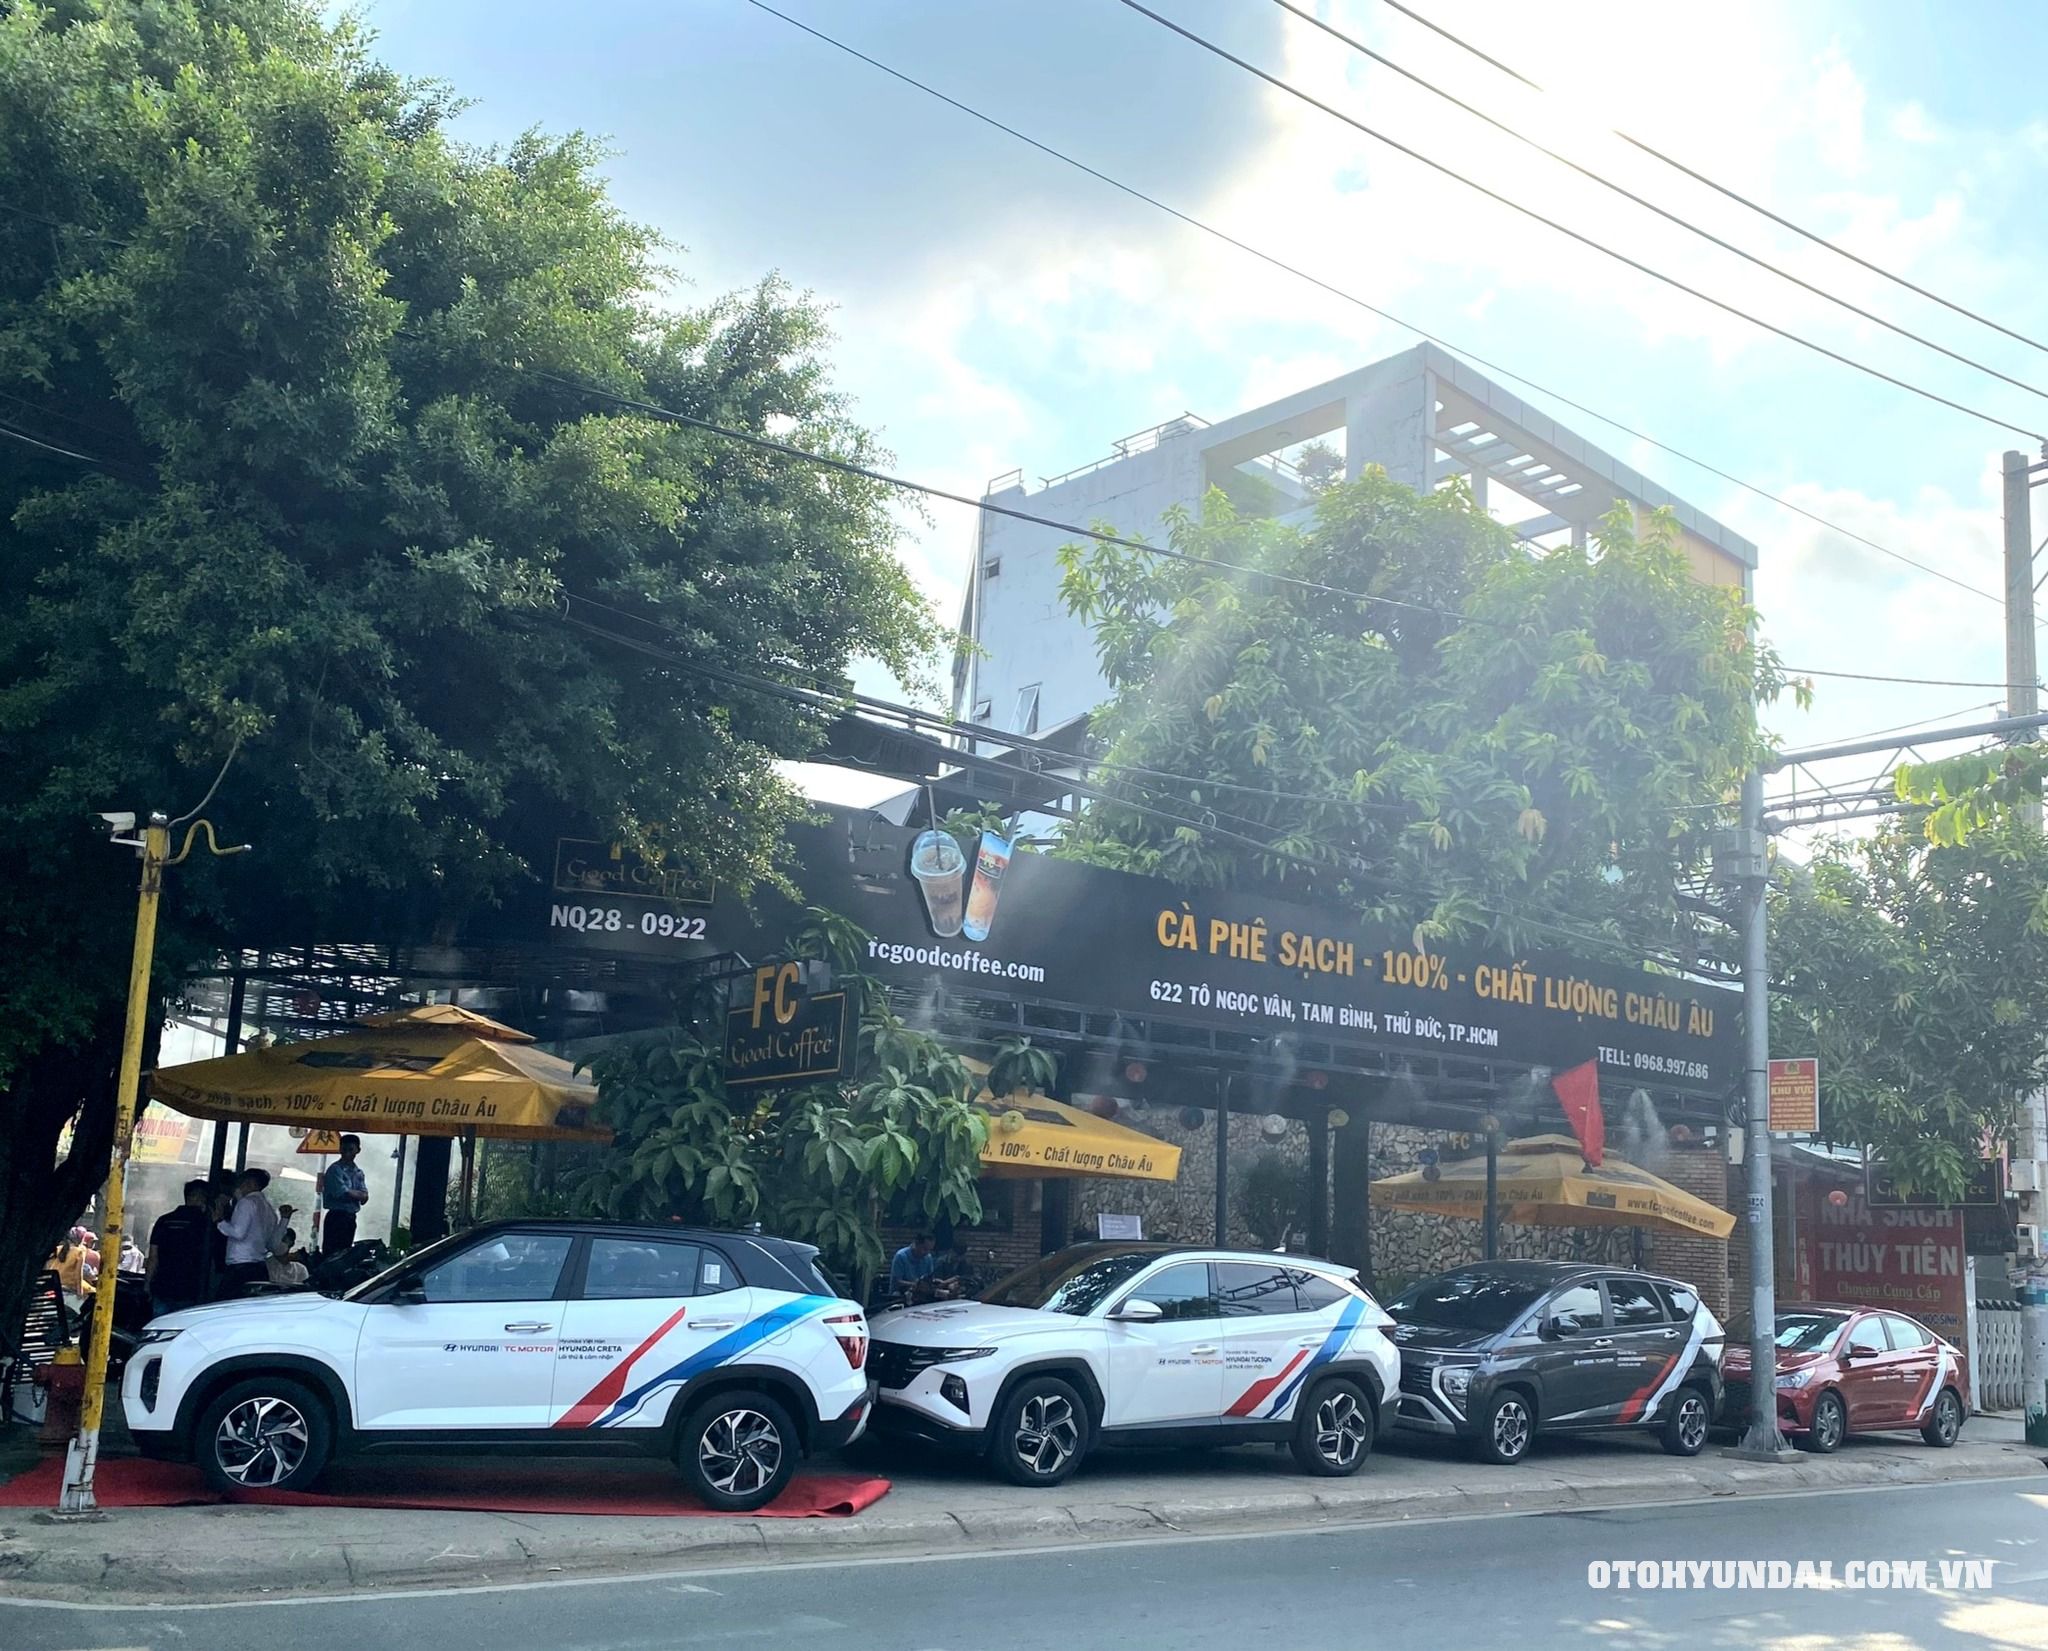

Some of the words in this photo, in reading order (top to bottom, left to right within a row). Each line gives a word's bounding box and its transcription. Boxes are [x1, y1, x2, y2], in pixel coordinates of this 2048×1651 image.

[567, 859, 625, 882] Good
[631, 866, 704, 897] Coffee
[550, 904, 622, 932] NQ28
[641, 912, 707, 940] 0922
[867, 938, 1045, 982] fcgoodcoffee.com
[1157, 901, 1198, 951] CÀ
[1209, 917, 1267, 963] PHÊ
[1278, 931, 1354, 979] SẠCH
[1364, 958, 1372, 967] -
[1383, 949, 1448, 991] 100%
[1457, 974, 1466, 982] -
[1475, 960, 1537, 1005] CHẤT
[1544, 975, 1618, 1022] LƯỢNG
[1625, 992, 1680, 1032] CHÂU
[1688, 999, 1714, 1037] ÂU
[752, 961, 800, 1029] FC
[1150, 980, 1182, 1003] 622
[1189, 983, 1211, 1006] TÔ
[1216, 989, 1258, 1017] NGỌC
[1263, 993, 1296, 1022] VÂN,
[1302, 1001, 1334, 1024] TAM
[1340, 1004, 1378, 1033] BÌNH,
[1384, 1011, 1411, 1035] THỦ
[1415, 1015, 1446, 1042] ĐỨC,
[1448, 1022, 1498, 1047] TP.HCM
[731, 1033, 772, 1065] Good
[776, 1027, 832, 1069] Coffee
[1598, 1046, 1631, 1068] TELL:
[1633, 1054, 1709, 1080] 0968.997.686
[285, 1094, 324, 1110] 100%
[342, 1093, 378, 1113] Chất
[383, 1096, 426, 1118] lượng
[431, 1096, 469, 1117] Châu
[475, 1096, 497, 1117] Âu
[1000, 1142, 1031, 1159] 100%
[1044, 1146, 1069, 1163] Chất
[1073, 1150, 1104, 1169] lượng
[1107, 1153, 1136, 1171] Châu
[1138, 1154, 1153, 1172] Âu
[1452, 1134, 1470, 1150] FC
[1820, 1231, 1887, 1274] THỦY
[1896, 1237, 1959, 1277] TIÊN
[1916, 1281, 1941, 1300] Cấp
[460, 1344, 499, 1352] HYUNDAI
